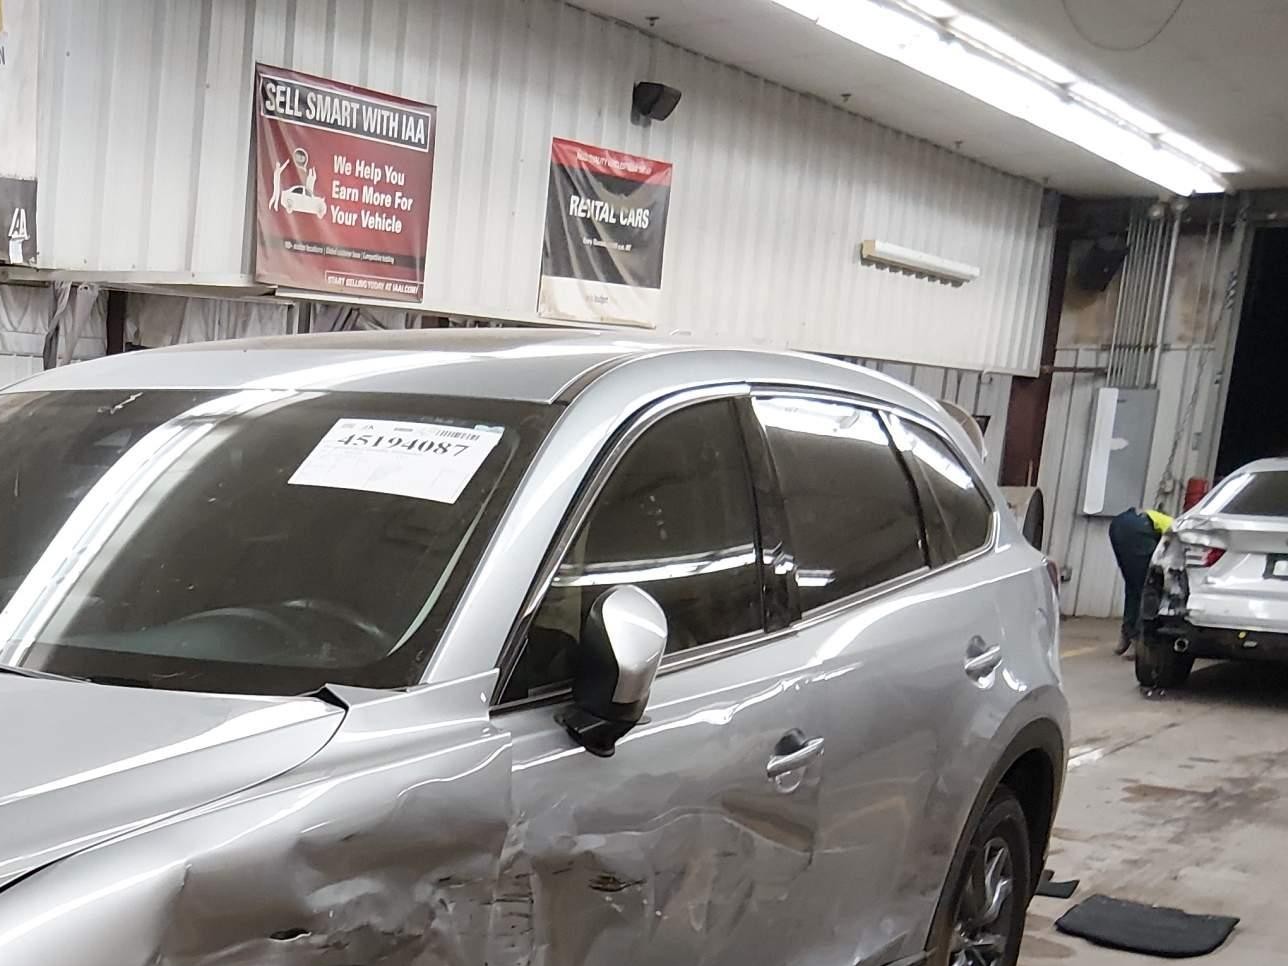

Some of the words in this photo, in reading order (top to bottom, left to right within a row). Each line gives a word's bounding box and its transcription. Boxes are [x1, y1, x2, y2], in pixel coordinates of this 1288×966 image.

[265, 82, 302, 118] SELL
[306, 92, 360, 129] SMART
[362, 105, 399, 139] WITH
[402, 114, 425, 145] IAA
[333, 154, 352, 176] We
[355, 159, 382, 185] Help
[384, 164, 405, 186] You
[331, 180, 359, 202] Earn
[362, 185, 392, 208] More
[394, 191, 414, 212] For
[569, 194, 617, 224] RENTAL
[619, 207, 650, 229] CARS
[330, 205, 359, 227] Your
[361, 209, 402, 234] Vehicle
[337, 433, 471, 457] 45194087
